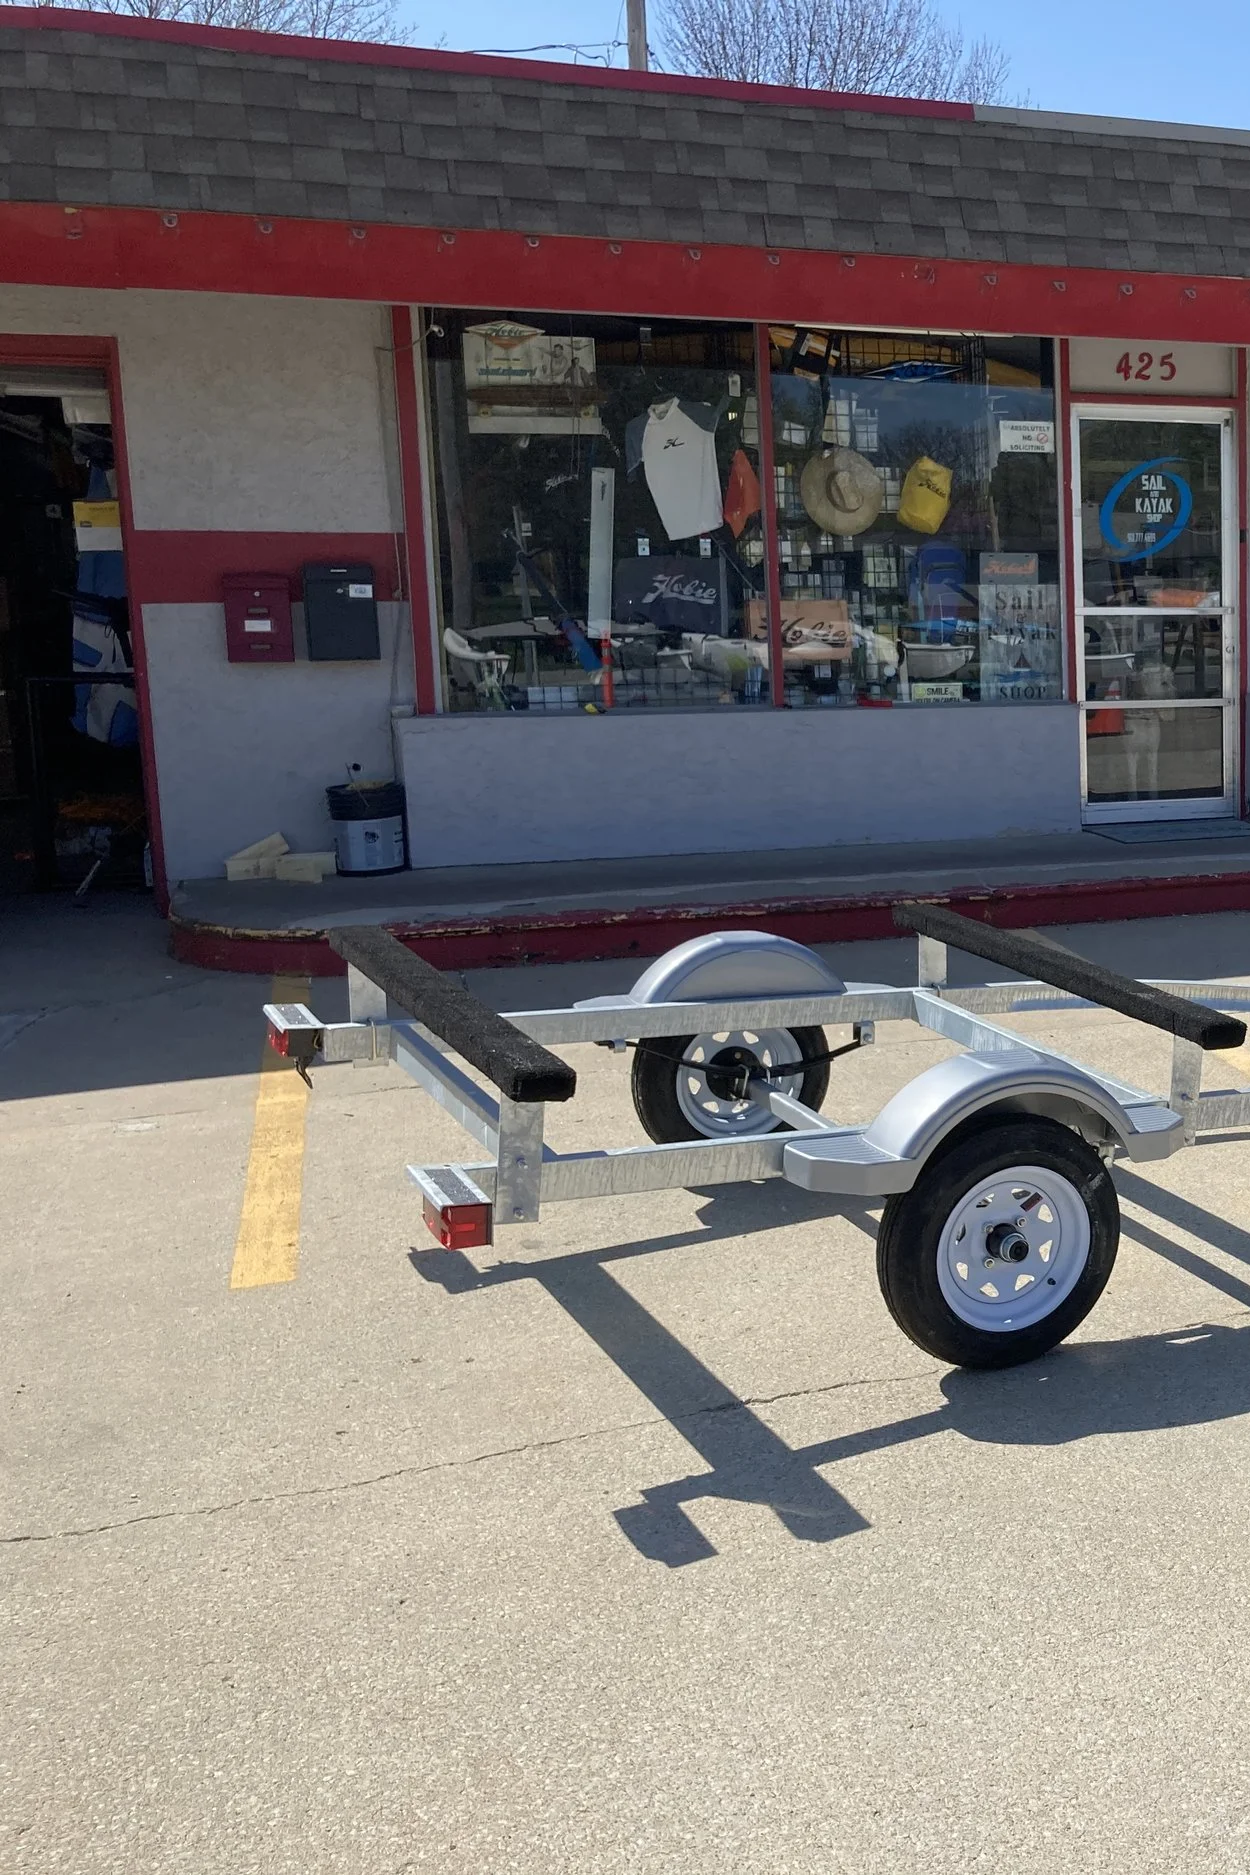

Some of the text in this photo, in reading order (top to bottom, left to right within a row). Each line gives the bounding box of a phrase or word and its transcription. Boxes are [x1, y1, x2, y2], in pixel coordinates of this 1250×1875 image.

[1116, 352, 1177, 381] 425
[1141, 474, 1167, 490] SAIL
[1135, 498, 1174, 514] KAYAK
[1146, 513, 1163, 523] SHOP
[641, 574, 717, 605] Hobie
[995, 590, 1043, 610] Sail
[926, 687, 950, 696] SMILE
